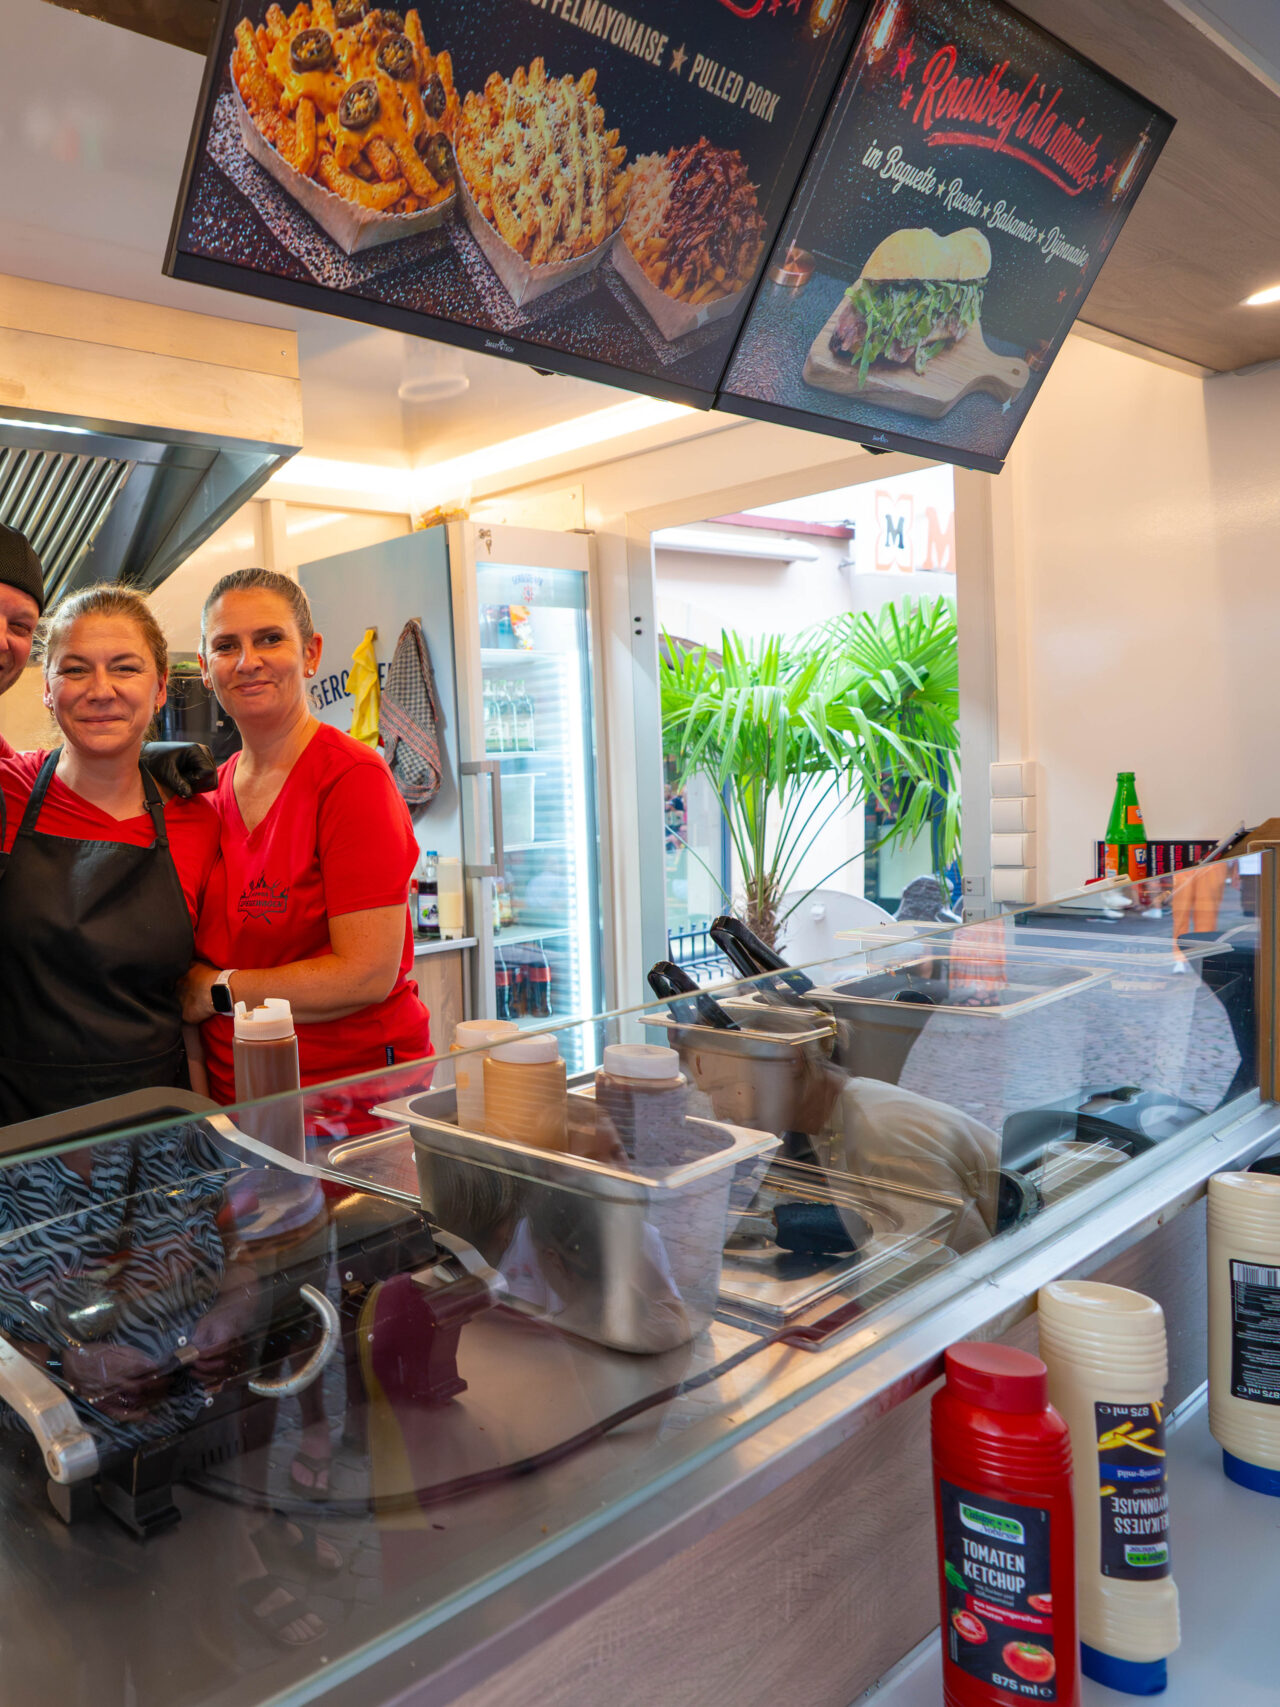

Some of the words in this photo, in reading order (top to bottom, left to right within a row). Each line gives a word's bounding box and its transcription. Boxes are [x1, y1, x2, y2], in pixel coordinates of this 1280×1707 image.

[688, 53, 744, 104] PULLED
[740, 81, 781, 123] PORK
[912, 45, 1040, 152] Roastbeef
[862, 139, 882, 170] im
[879, 145, 937, 194] Baguette
[943, 177, 984, 218] Rucola
[987, 200, 1038, 244] Balsamico
[884, 514, 905, 549] M
[1113, 1406, 1128, 1417] ml
[1130, 1407, 1149, 1417] 875
[961, 1537, 1026, 1574] TOMATEN
[963, 1558, 1026, 1594] KETCHUP
[992, 1673, 1019, 1690] 875
[1020, 1684, 1038, 1696] ml
